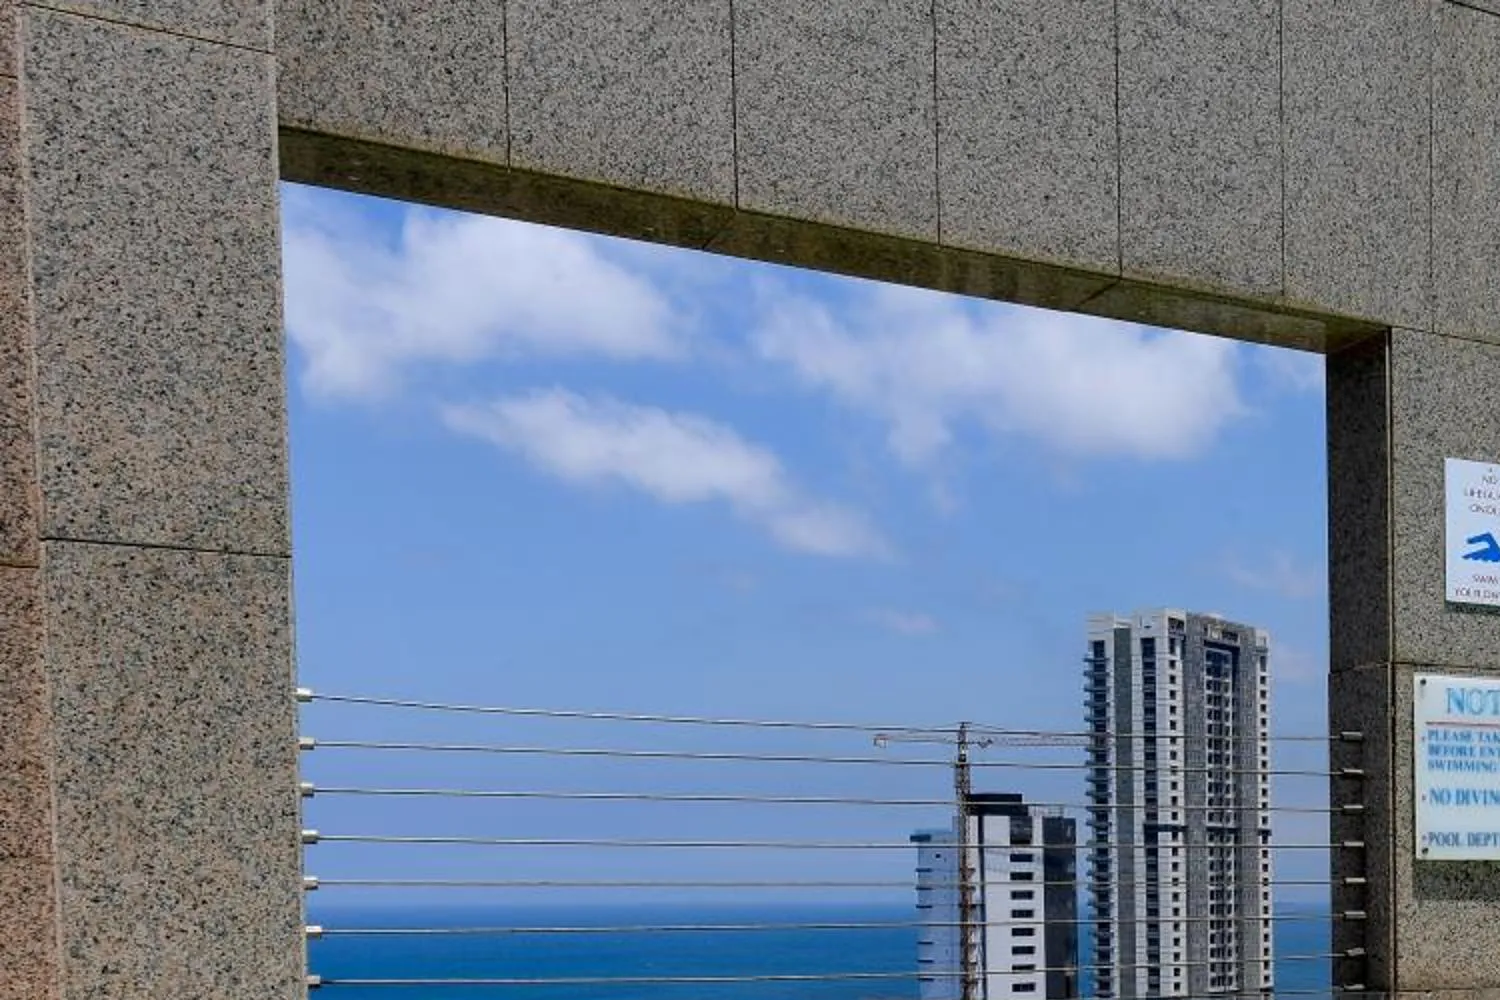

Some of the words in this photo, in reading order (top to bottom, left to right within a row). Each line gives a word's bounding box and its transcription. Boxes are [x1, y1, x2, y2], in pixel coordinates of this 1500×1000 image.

[1427, 729, 1472, 742] PLEASE
[1428, 743, 1475, 758] BEFORE
[1428, 759, 1497, 773] SWIMMING
[1429, 787, 1451, 806] NO
[1428, 831, 1462, 848] POOL
